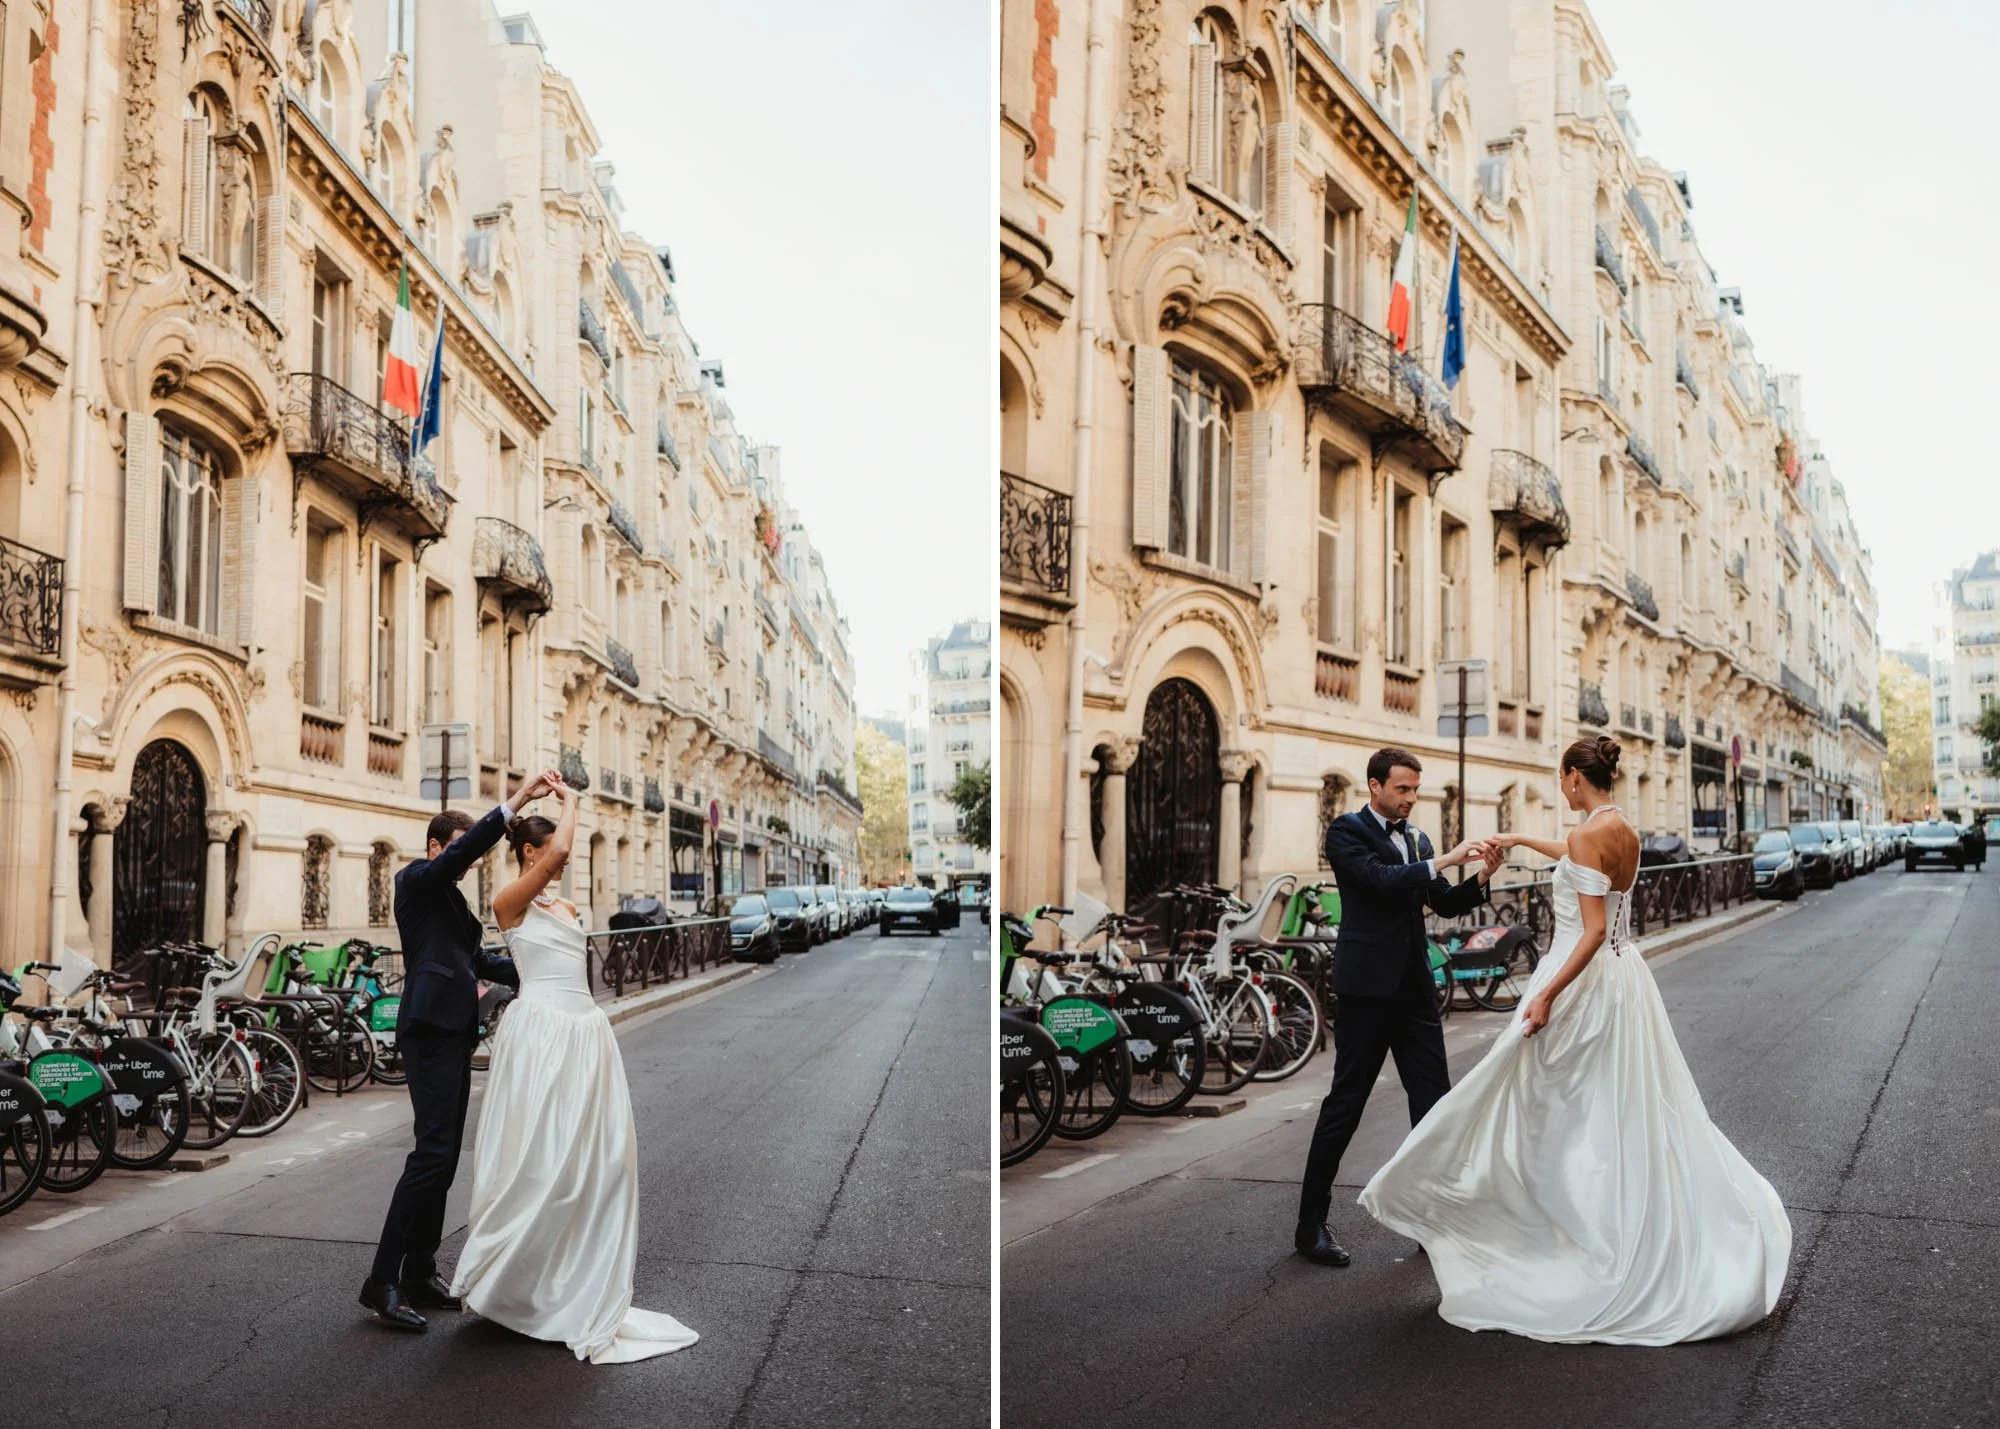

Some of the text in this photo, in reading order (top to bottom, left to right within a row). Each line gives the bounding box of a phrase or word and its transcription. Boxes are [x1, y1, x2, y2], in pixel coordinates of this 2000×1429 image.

[1120, 1007, 1138, 1016] Lime
[1145, 1005, 1167, 1014] Uber
[1157, 1014, 1180, 1023] Lime
[1002, 1046, 1032, 1058] Lime
[105, 1063, 124, 1071] Lime
[131, 1060, 152, 1070] Uber
[142, 1070, 165, 1079] Lime
